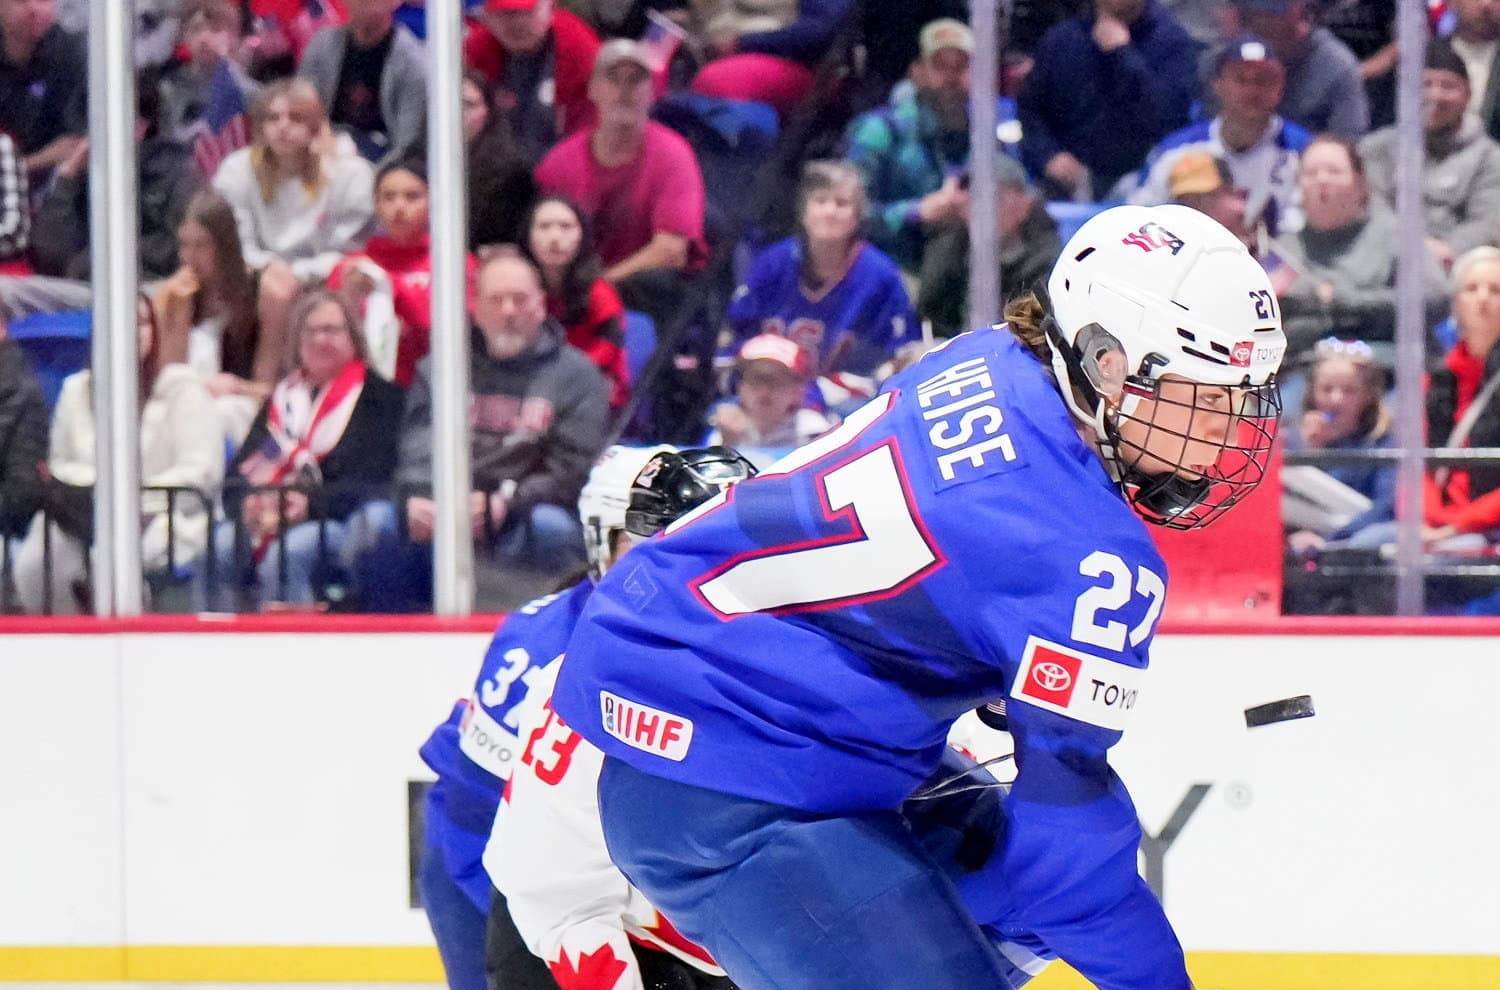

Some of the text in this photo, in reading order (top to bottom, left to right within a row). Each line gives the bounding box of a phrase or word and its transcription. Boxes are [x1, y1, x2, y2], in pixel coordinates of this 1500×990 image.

[1249, 290, 1276, 320] 27
[916, 357, 1017, 481] HEISE
[1070, 550, 1165, 653] 27
[1091, 678, 1139, 710] TOYO
[472, 724, 513, 763] TOYO
[616, 702, 684, 751] IIHF
